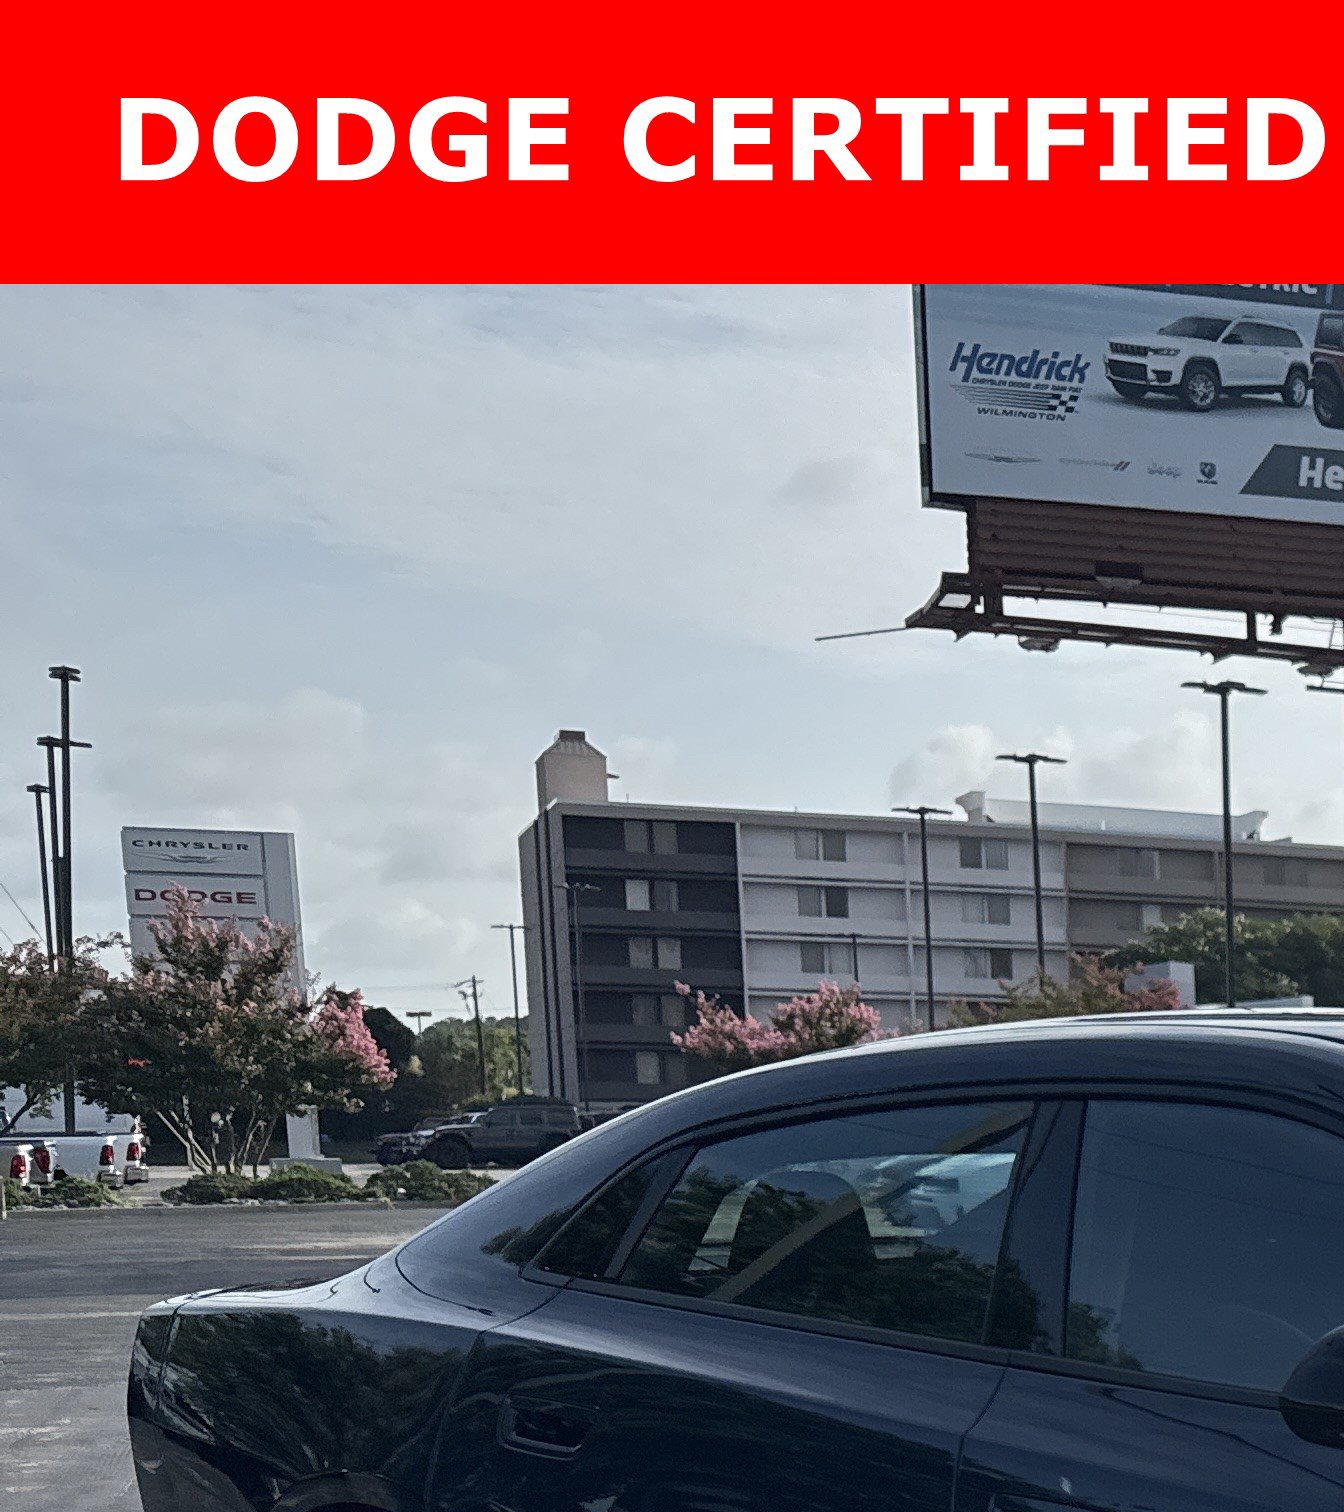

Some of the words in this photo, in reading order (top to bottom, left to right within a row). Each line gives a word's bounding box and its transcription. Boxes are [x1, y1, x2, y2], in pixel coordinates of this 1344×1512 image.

[949, 342, 1091, 383] Hendrick
[977, 407, 1067, 422] WILMINGTON
[131, 839, 250, 851] CHRYSLER
